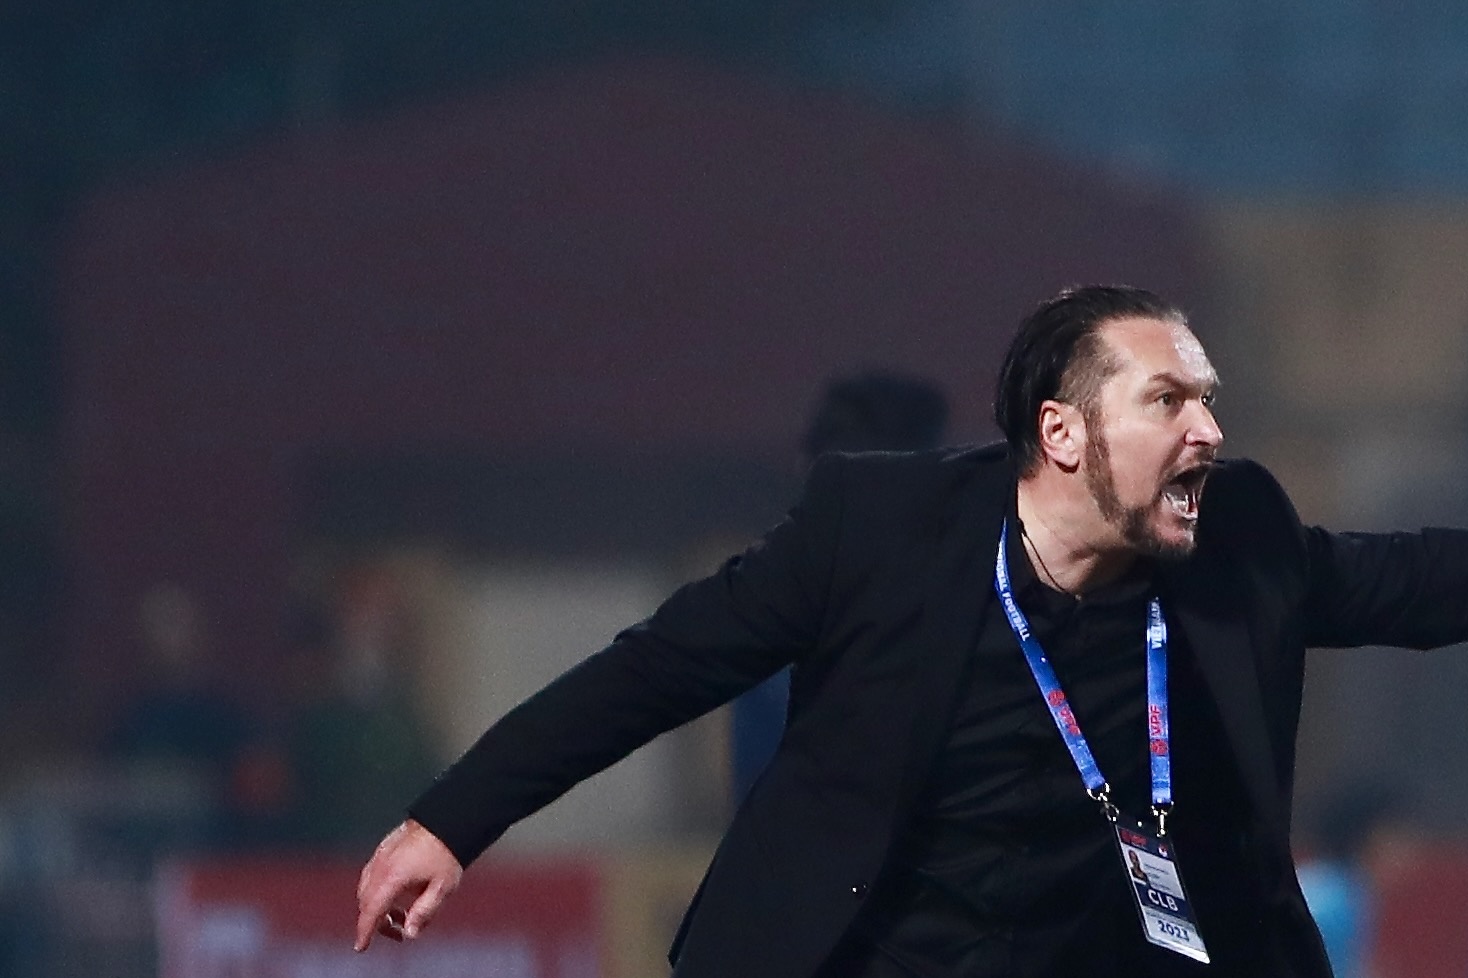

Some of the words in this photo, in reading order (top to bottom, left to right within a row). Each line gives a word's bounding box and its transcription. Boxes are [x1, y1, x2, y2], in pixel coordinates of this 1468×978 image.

[1002, 592, 1030, 642] FOOTBALL
[1150, 704, 1162, 736] VPF
[1147, 888, 1179, 912] CLB
[1157, 919, 1190, 943] 2023
